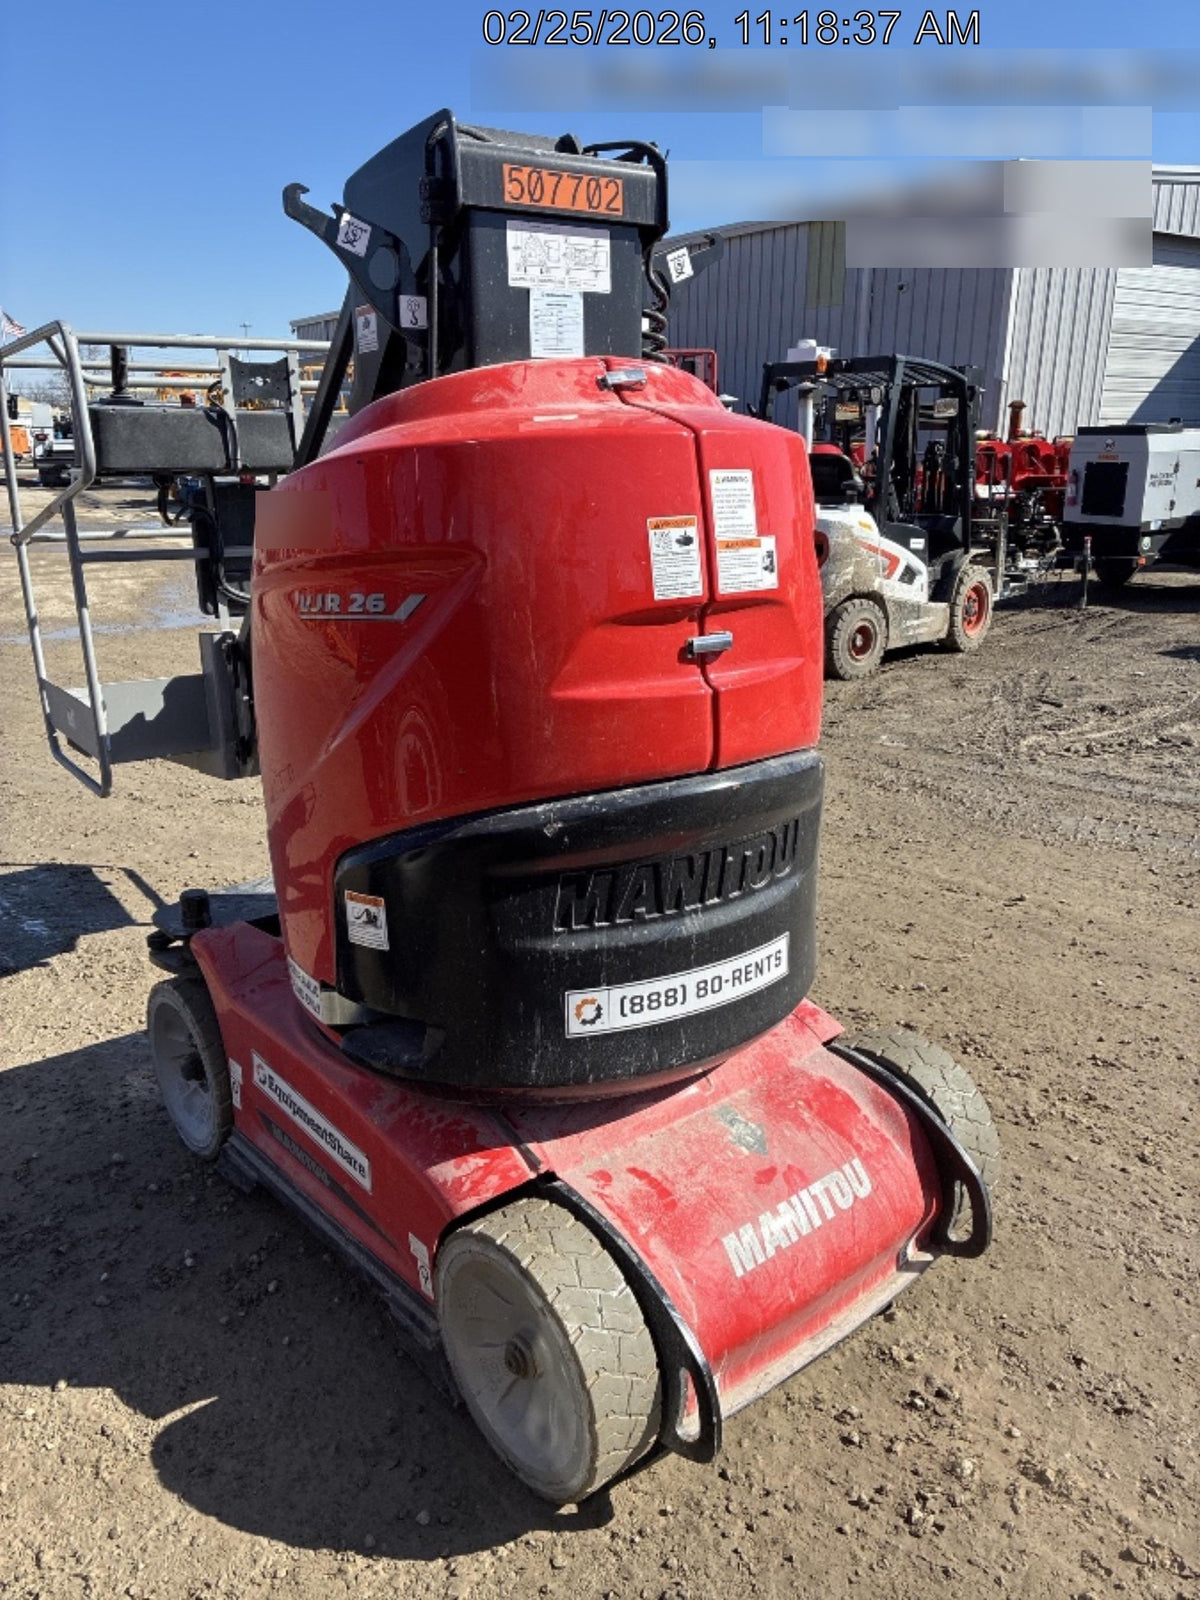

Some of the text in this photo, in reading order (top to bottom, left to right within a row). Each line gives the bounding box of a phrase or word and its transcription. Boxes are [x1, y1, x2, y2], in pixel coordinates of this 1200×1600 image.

[507, 166, 621, 213] 507702
[348, 593, 385, 612] 26
[553, 819, 799, 931] MANITOU
[619, 948, 783, 1018] (888) 80-RENTS
[268, 1072, 367, 1179] EquipmentShare
[721, 1156, 873, 1279] MANITOU
